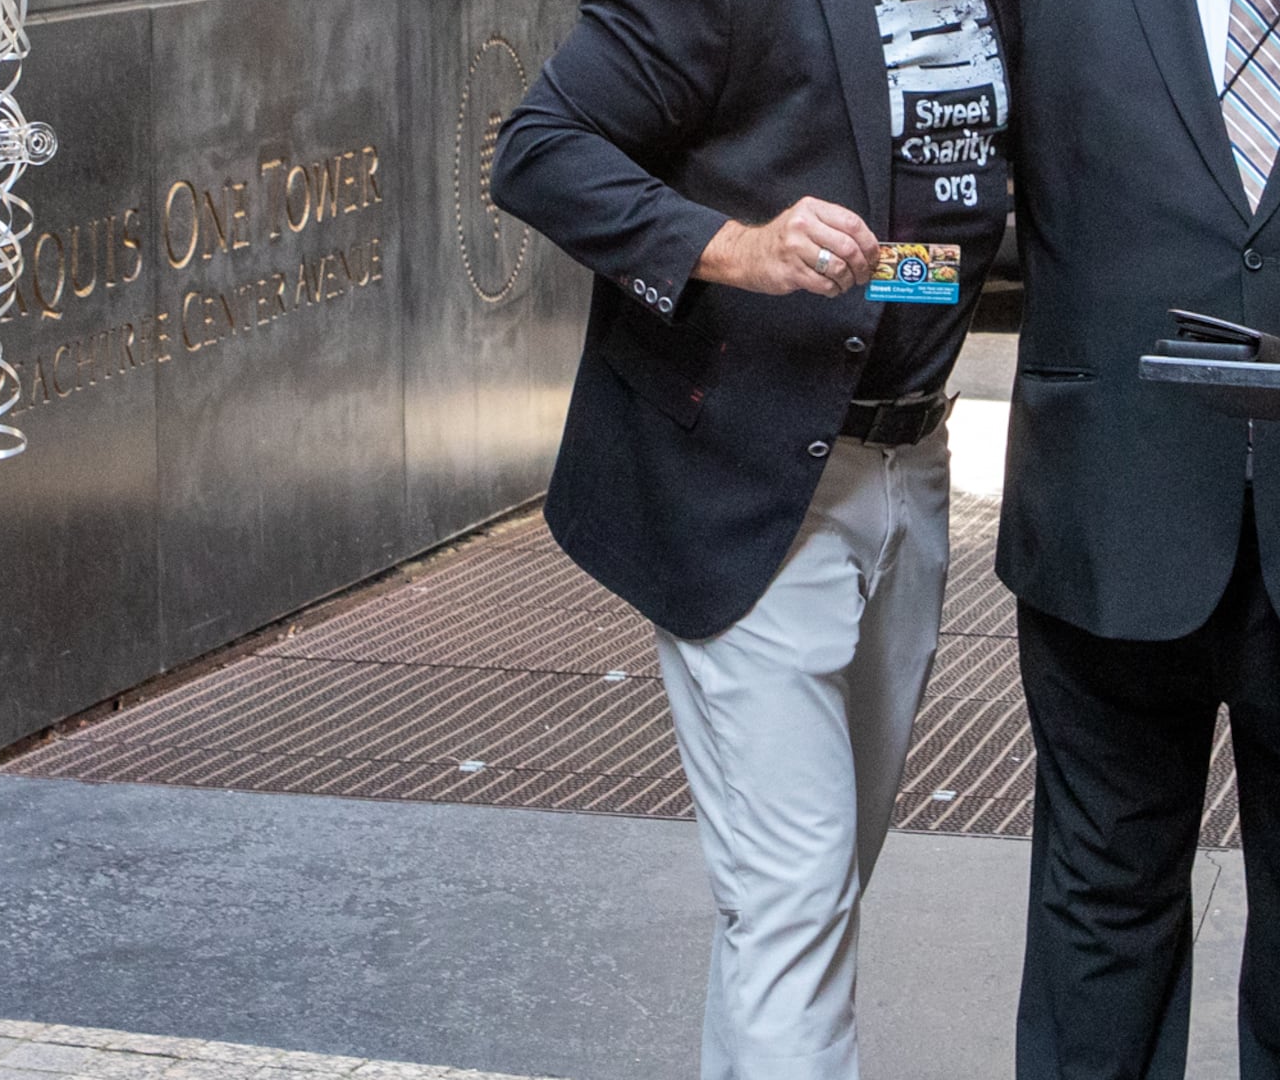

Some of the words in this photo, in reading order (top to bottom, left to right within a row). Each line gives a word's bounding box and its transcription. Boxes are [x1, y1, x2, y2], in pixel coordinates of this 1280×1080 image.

[915, 94, 991, 129] Street
[901, 128, 995, 166] Charity.
[165, 179, 251, 269] ONE
[261, 145, 382, 239] TOWER
[934, 173, 978, 206] org
[902, 264, 922, 276] $5
